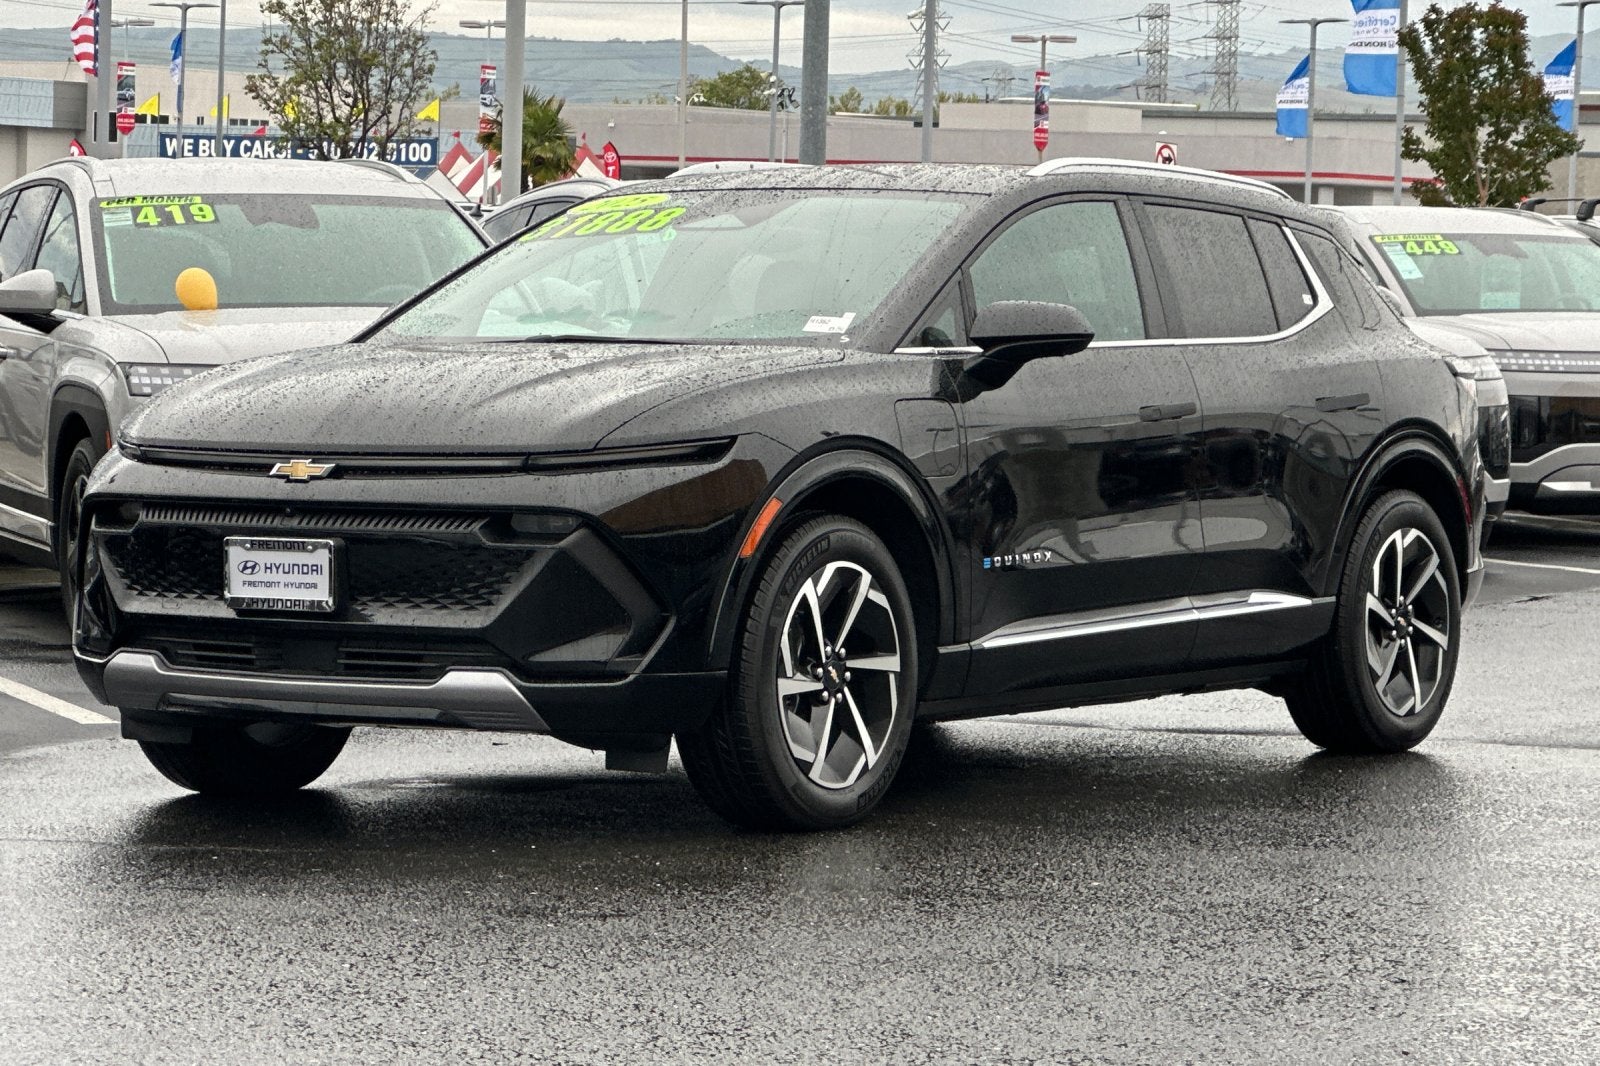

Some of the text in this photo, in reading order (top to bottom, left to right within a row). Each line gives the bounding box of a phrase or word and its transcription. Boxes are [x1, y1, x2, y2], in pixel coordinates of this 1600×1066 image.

[165, 137, 194, 156] WE
[136, 203, 216, 226] 419
[1405, 239, 1460, 255] 449
[250, 540, 306, 551] FREMONT
[983, 550, 1052, 569] EQUINOX
[264, 562, 323, 576] HYUNDAI
[242, 580, 318, 590] FREMONT HYUNDAI
[250, 598, 306, 610] HYUNDAI
